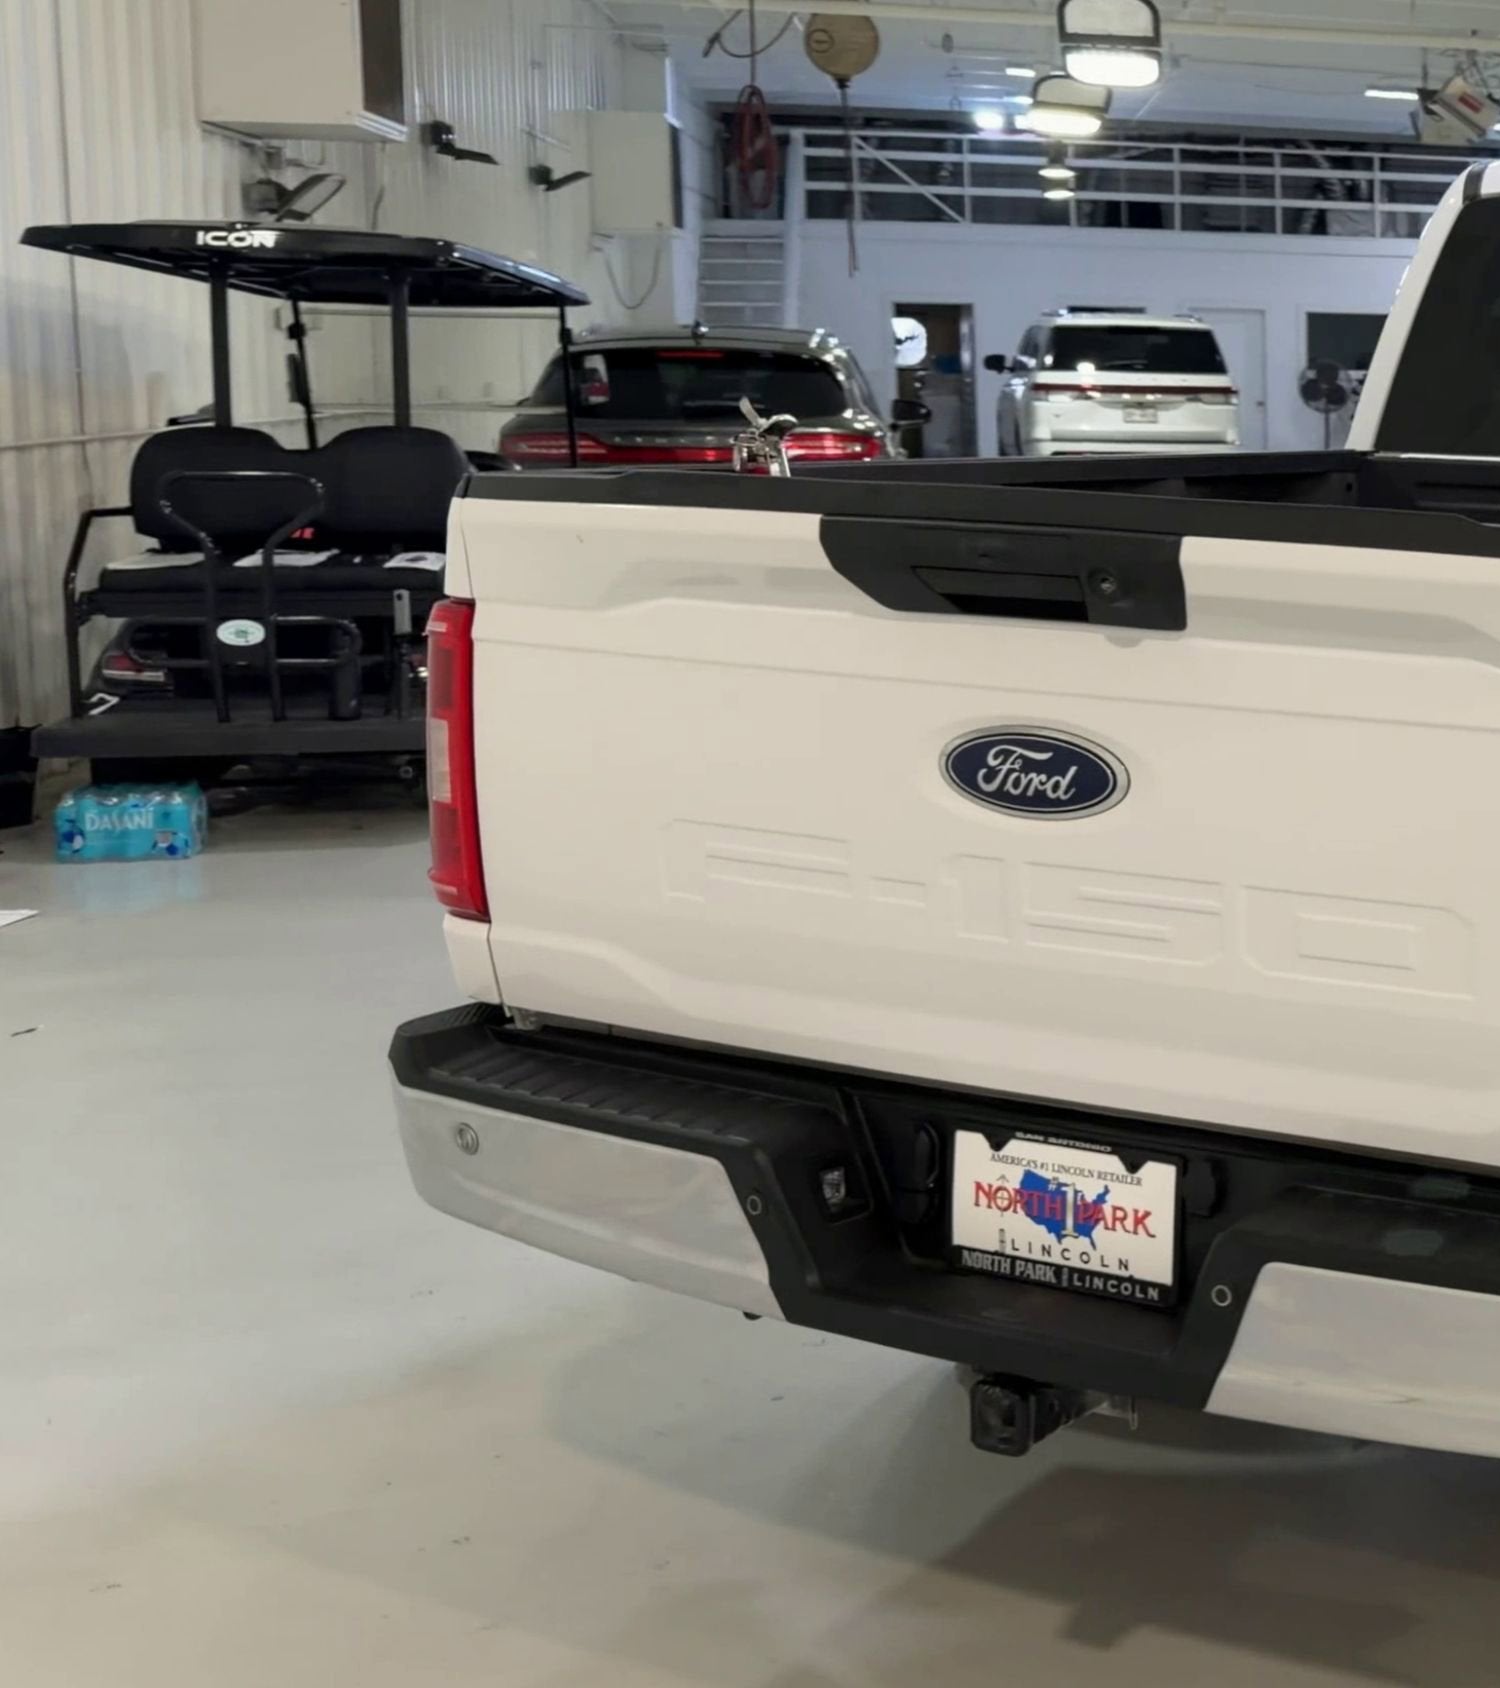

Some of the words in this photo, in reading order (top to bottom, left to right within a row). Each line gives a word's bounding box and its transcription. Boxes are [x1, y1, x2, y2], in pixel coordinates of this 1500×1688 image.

[196, 229, 284, 248] ICON
[977, 744, 1078, 800] Ford
[84, 809, 154, 832] DASANI
[660, 817, 1476, 1000] F-150
[1014, 1131, 1045, 1142] SAN
[990, 1153, 1038, 1169] AMERICA'S
[1051, 1163, 1096, 1179] LINCOLN
[1097, 1172, 1143, 1187] RETAILER
[974, 1181, 1063, 1221] NORTH
[1076, 1196, 1156, 1238] PARK
[1011, 1238, 1130, 1271] LINCOLN
[961, 1249, 1011, 1273] NORTH
[1014, 1259, 1057, 1283] PARK
[1072, 1274, 1160, 1300] LINCOLN
